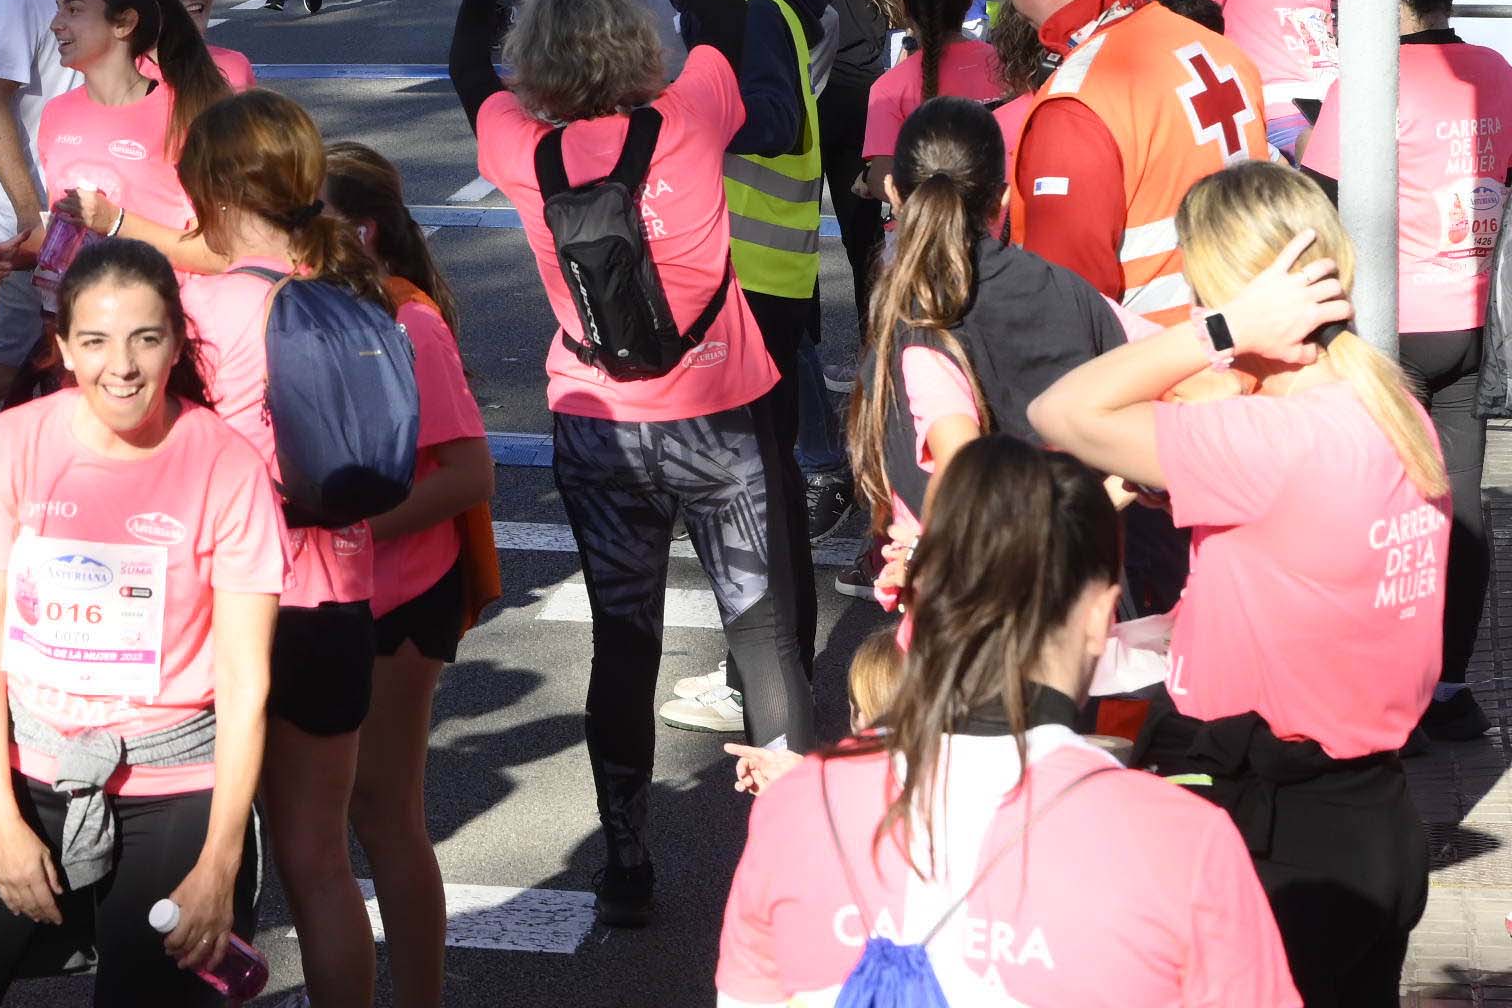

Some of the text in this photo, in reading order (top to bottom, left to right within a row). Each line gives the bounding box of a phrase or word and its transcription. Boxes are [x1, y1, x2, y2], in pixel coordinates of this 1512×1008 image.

[1436, 116, 1503, 139] CARRERA
[1450, 137, 1494, 157] DE LA
[1445, 155, 1496, 175] MUJER
[1471, 218, 1498, 234] 016
[1369, 505, 1445, 550] CARRERA
[1386, 543, 1437, 578] DE LA
[48, 565, 108, 583] ASTURIANA
[1373, 568, 1437, 609] MUJER
[46, 601, 103, 624] 016
[832, 905, 1055, 969] CAERA
